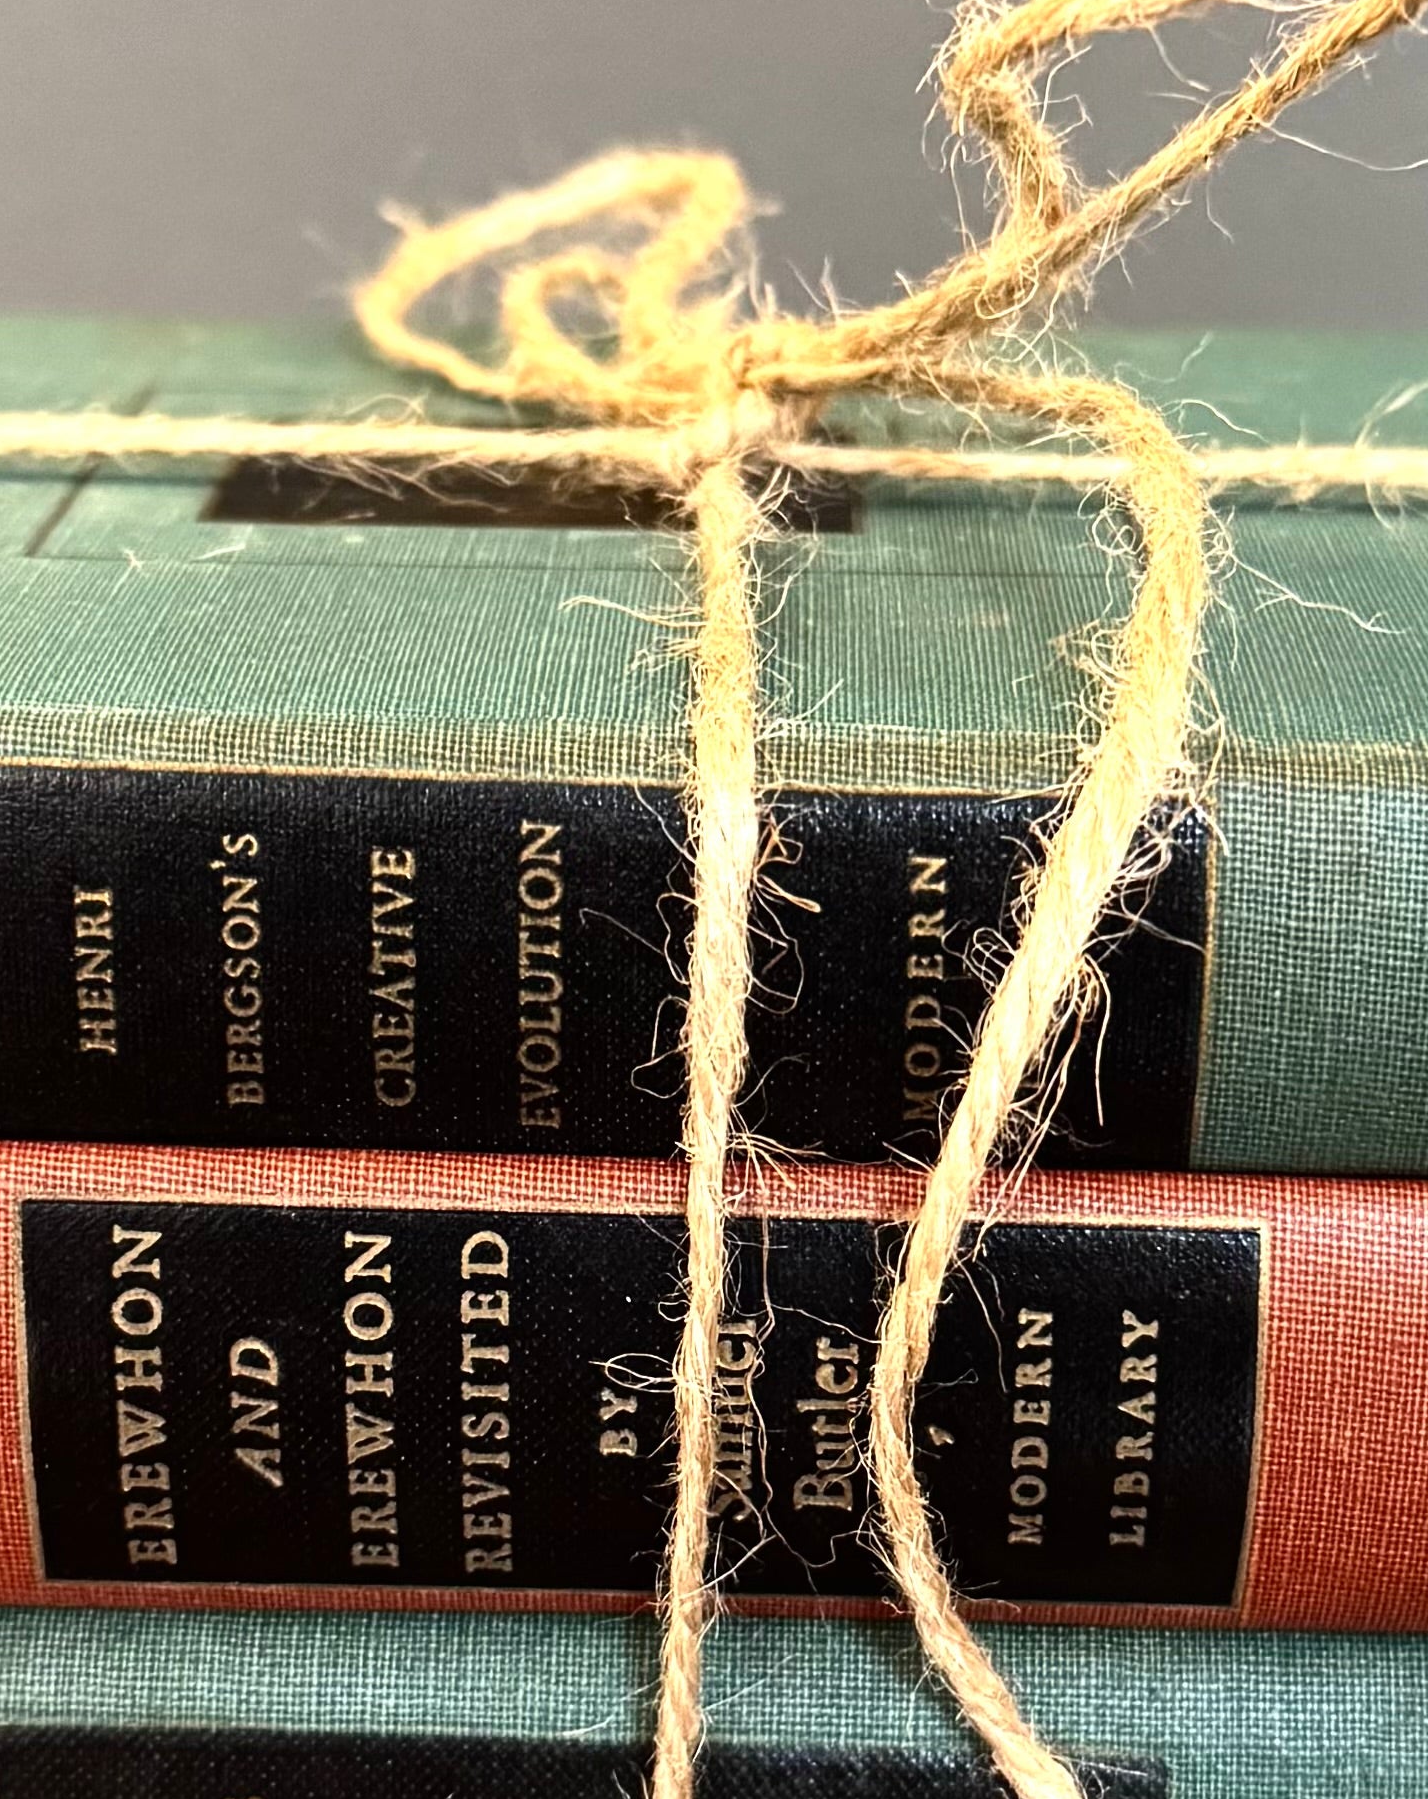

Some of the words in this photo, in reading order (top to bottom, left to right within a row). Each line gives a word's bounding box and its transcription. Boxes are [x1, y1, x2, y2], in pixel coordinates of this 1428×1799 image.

[73, 885, 118, 1054] HENRI
[209, 832, 265, 1106] BERGSON'S
[369, 846, 417, 1108] CREATIVE
[517, 817, 564, 1130] EVOLUTION
[903, 855, 948, 1122] MODERN
[110, 1223, 177, 1565] EREWHON
[229, 1336, 284, 1489] AND
[342, 1230, 400, 1568] EREWHON
[459, 1230, 513, 1573] REVISITED
[598, 1386, 639, 1457] BY
[792, 1336, 861, 1512] Butler
[1008, 1307, 1055, 1547] MODERN
[1108, 1309, 1160, 1548] LIBRARY
